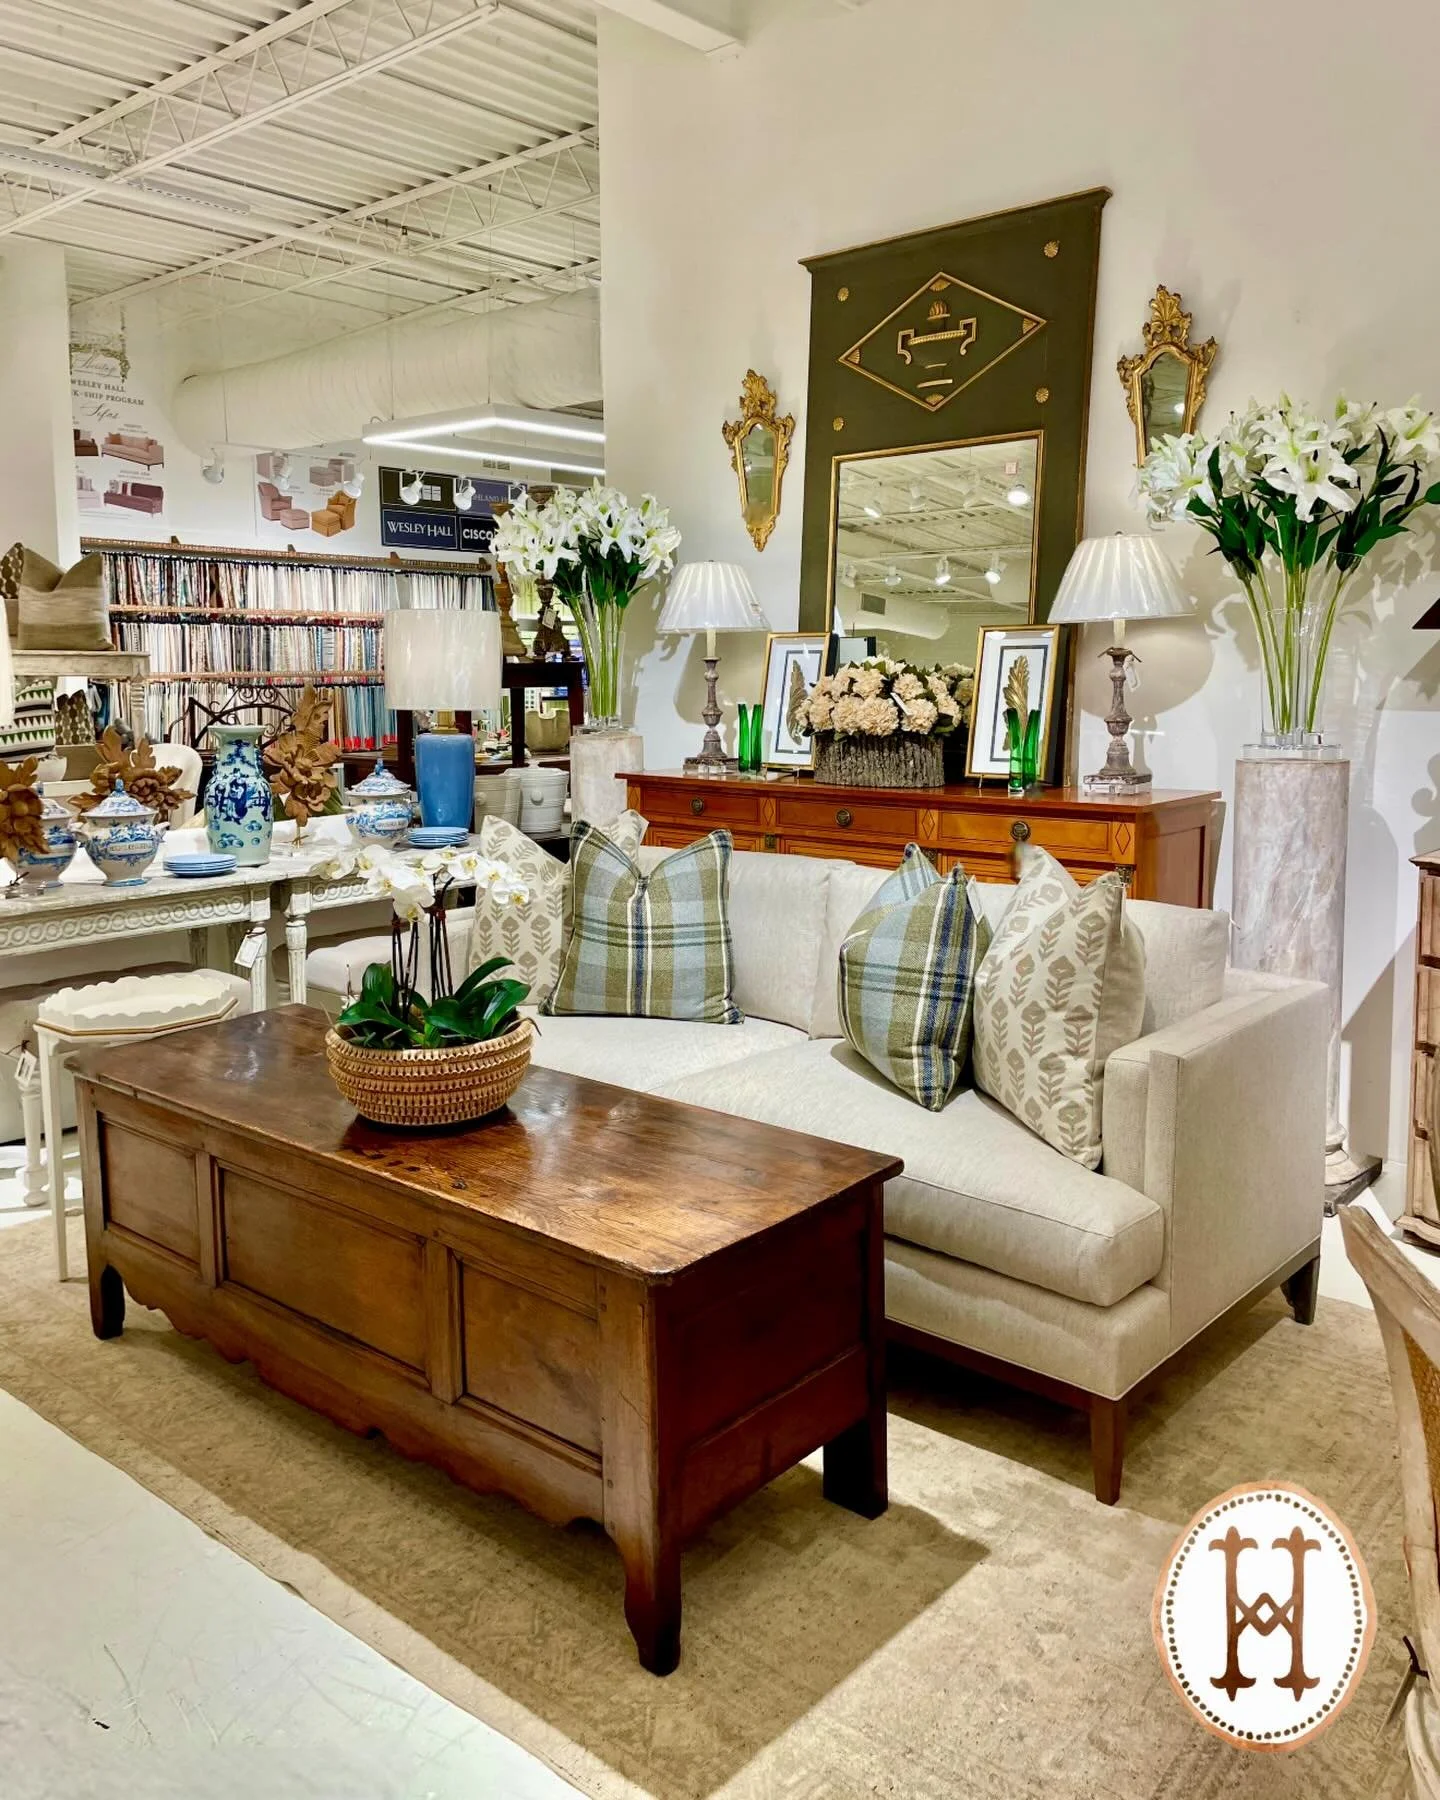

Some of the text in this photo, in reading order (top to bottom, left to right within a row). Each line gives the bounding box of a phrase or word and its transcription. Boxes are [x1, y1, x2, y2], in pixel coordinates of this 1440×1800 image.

[104, 383, 126, 392] HALL
[106, 394, 144, 405] PROGRAM
[387, 521, 453, 537] WESLEY HALL
[462, 528, 494, 541] CISCO
